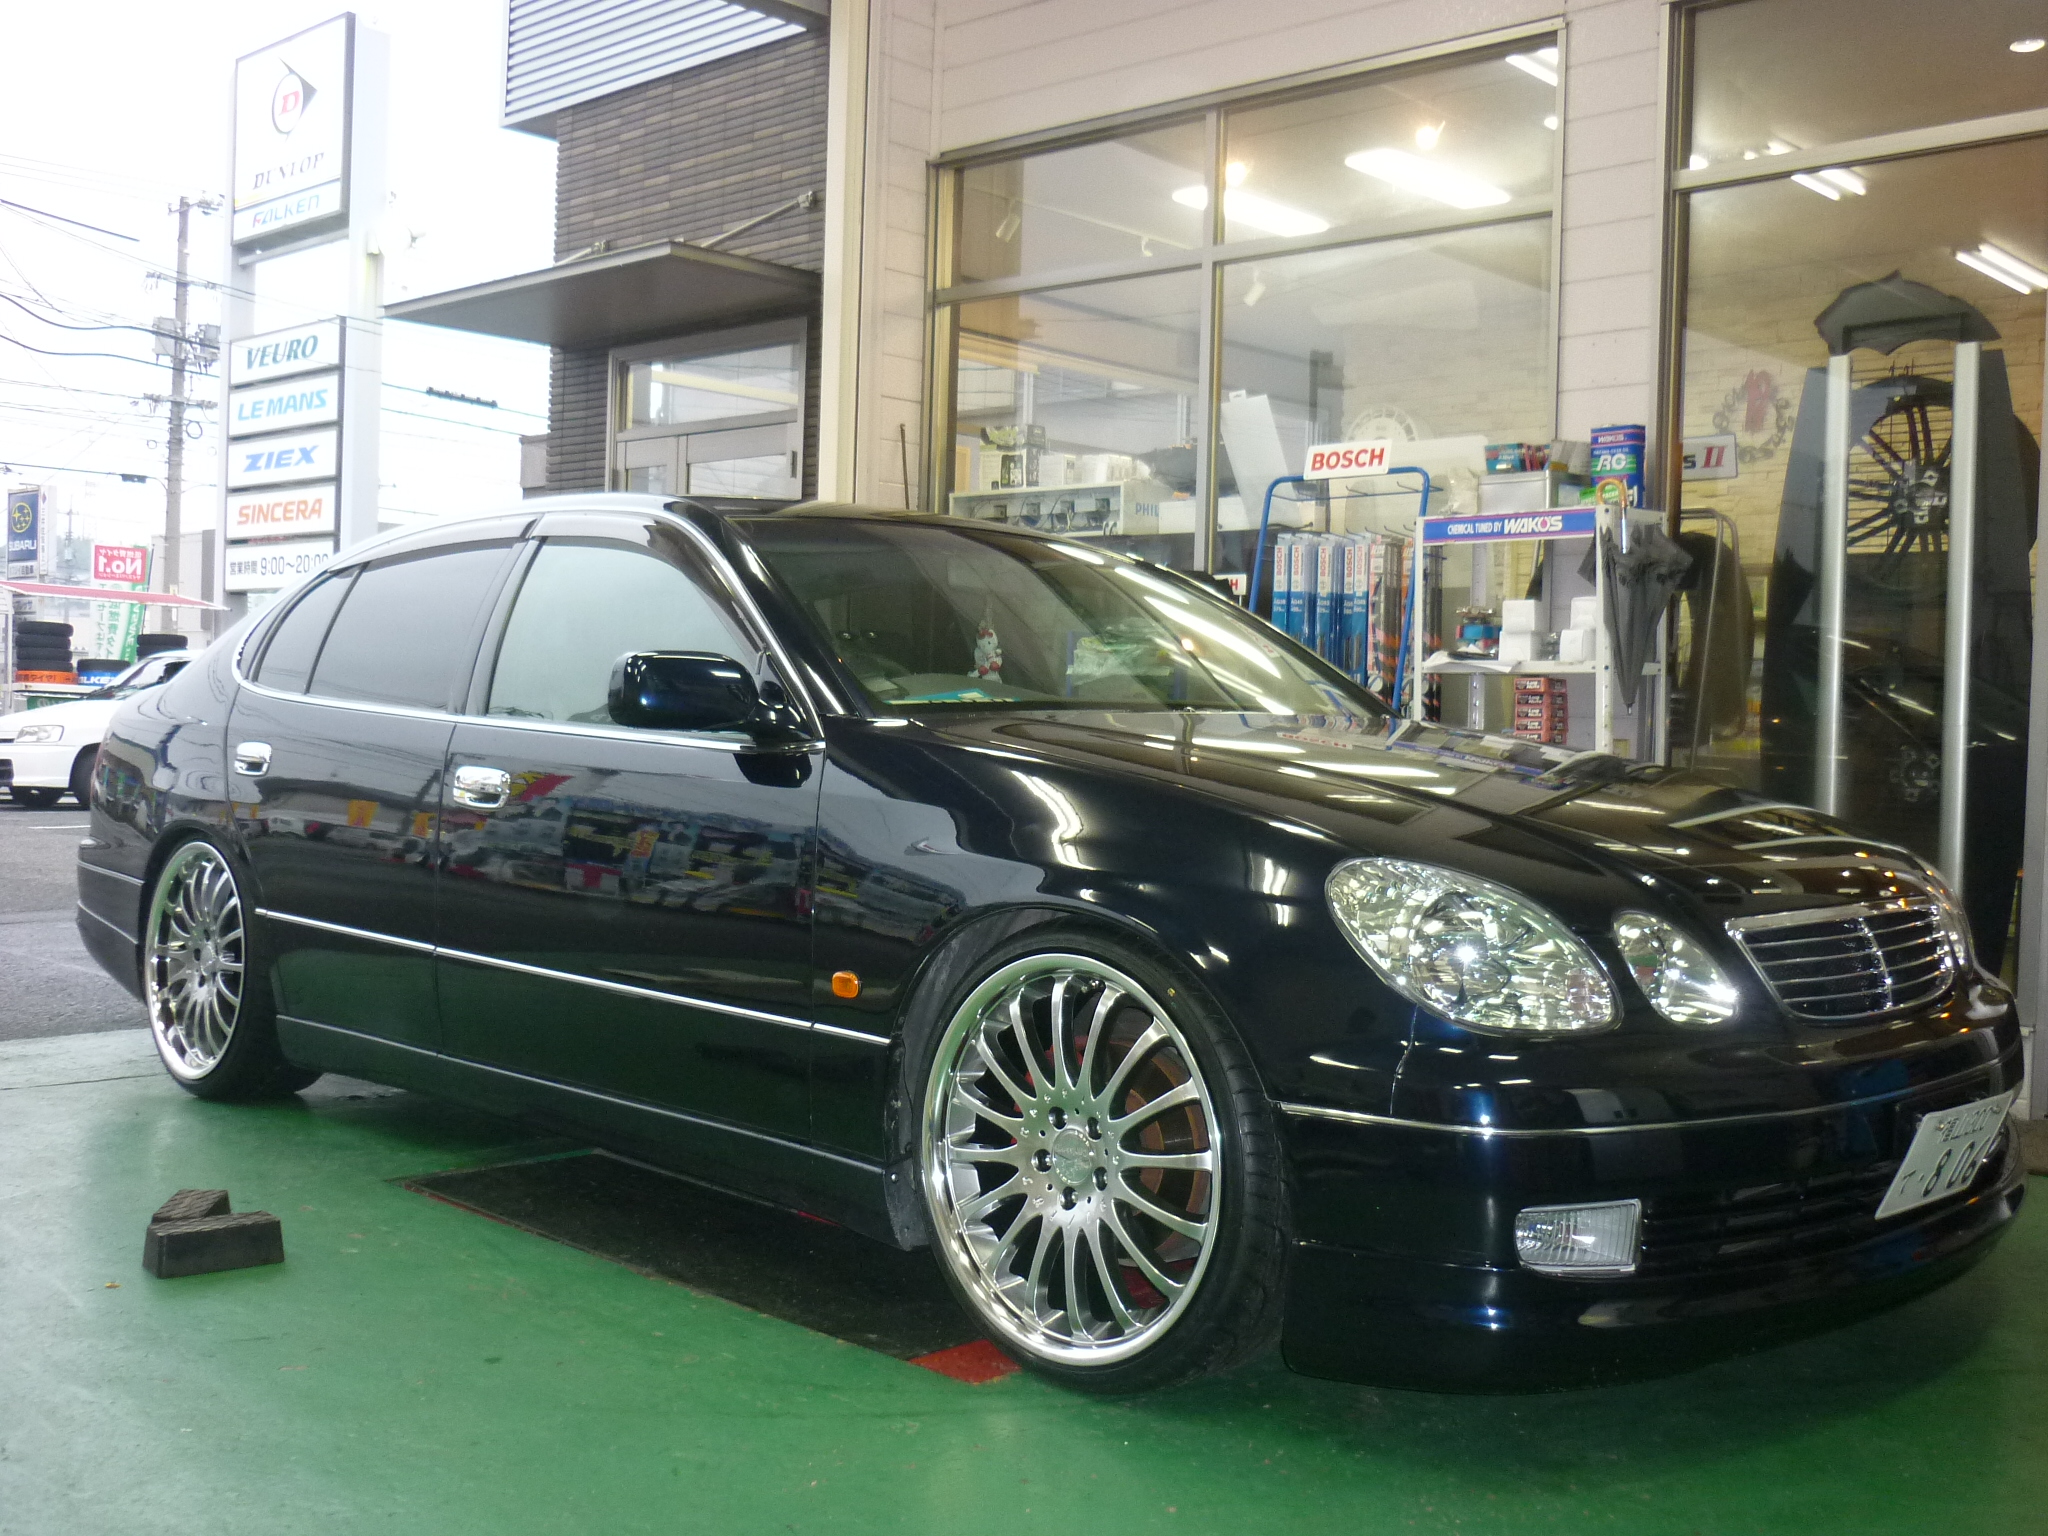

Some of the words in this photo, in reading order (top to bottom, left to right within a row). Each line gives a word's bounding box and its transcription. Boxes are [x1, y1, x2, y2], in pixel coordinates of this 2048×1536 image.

[253, 152, 324, 190] DUNLOP
[252, 194, 320, 228] FALKEN
[247, 334, 319, 370] VEURO
[237, 401, 265, 421] LE
[266, 388, 328, 417] MANS
[243, 445, 319, 473] ZIEX
[1311, 447, 1385, 472] BOSCH
[237, 498, 323, 526] SINCERA
[1136, 502, 1159, 517] PHIL
[1447, 520, 1475, 535] CHEMICAL
[1475, 521, 1493, 534] TUNED
[1493, 520, 1503, 533] BY
[9, 540, 37, 551] SUBARU
[230, 560, 258, 576] 営業時間
